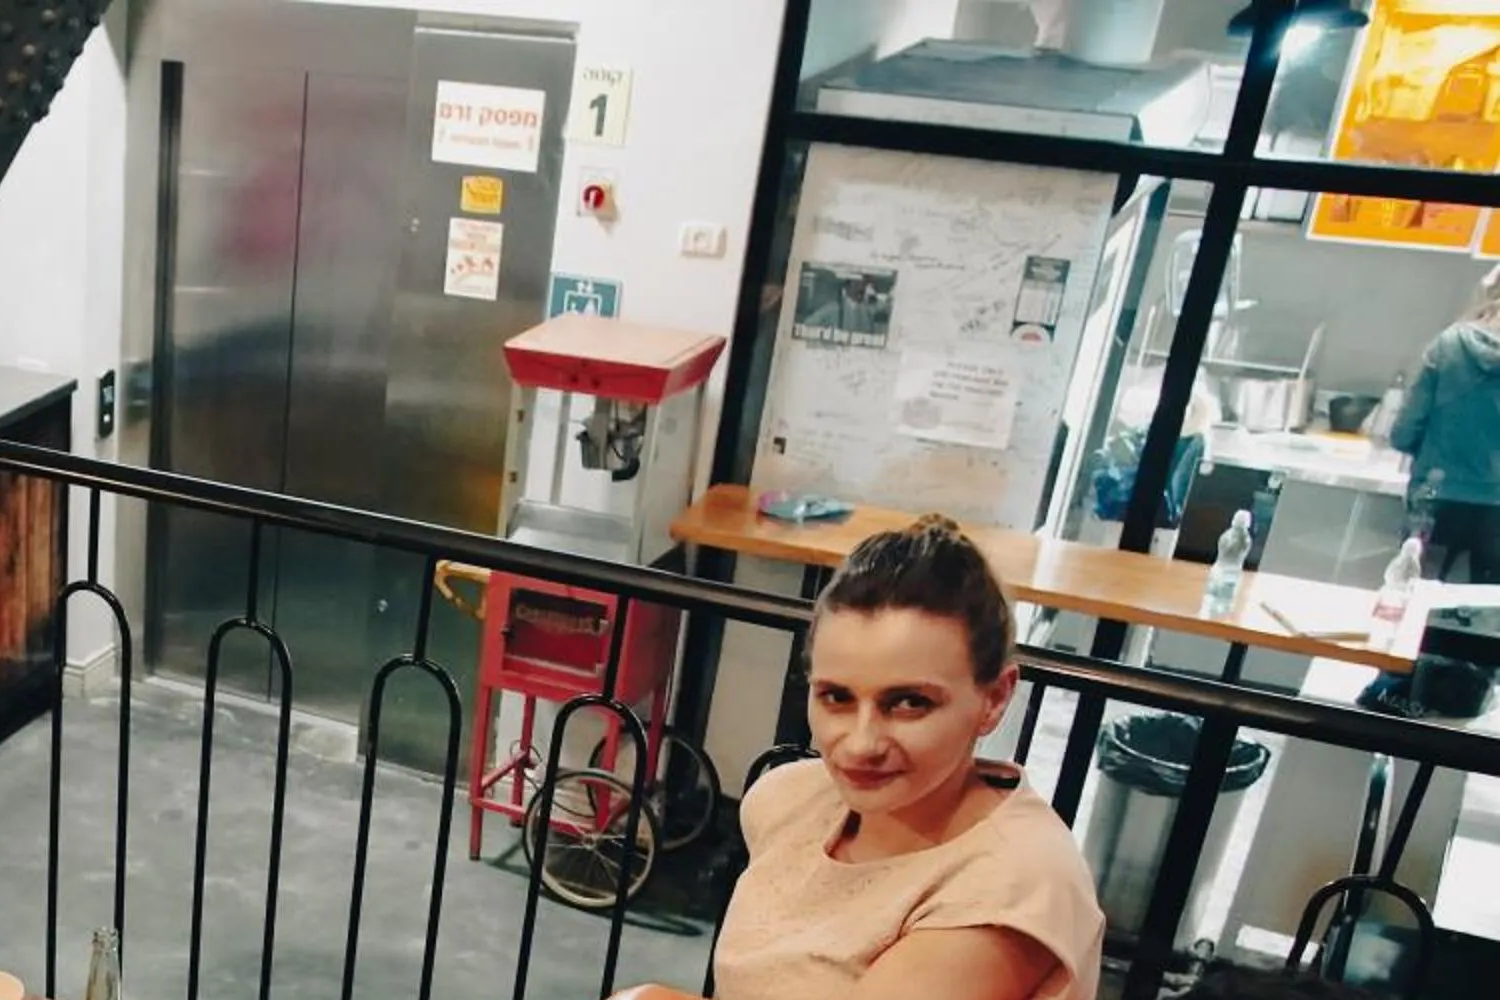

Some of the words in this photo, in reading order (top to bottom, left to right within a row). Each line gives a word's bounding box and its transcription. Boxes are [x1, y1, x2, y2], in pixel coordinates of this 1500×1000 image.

[440, 101, 472, 122] זרם
[479, 105, 538, 128] מפסק
[589, 93, 608, 137] 1
